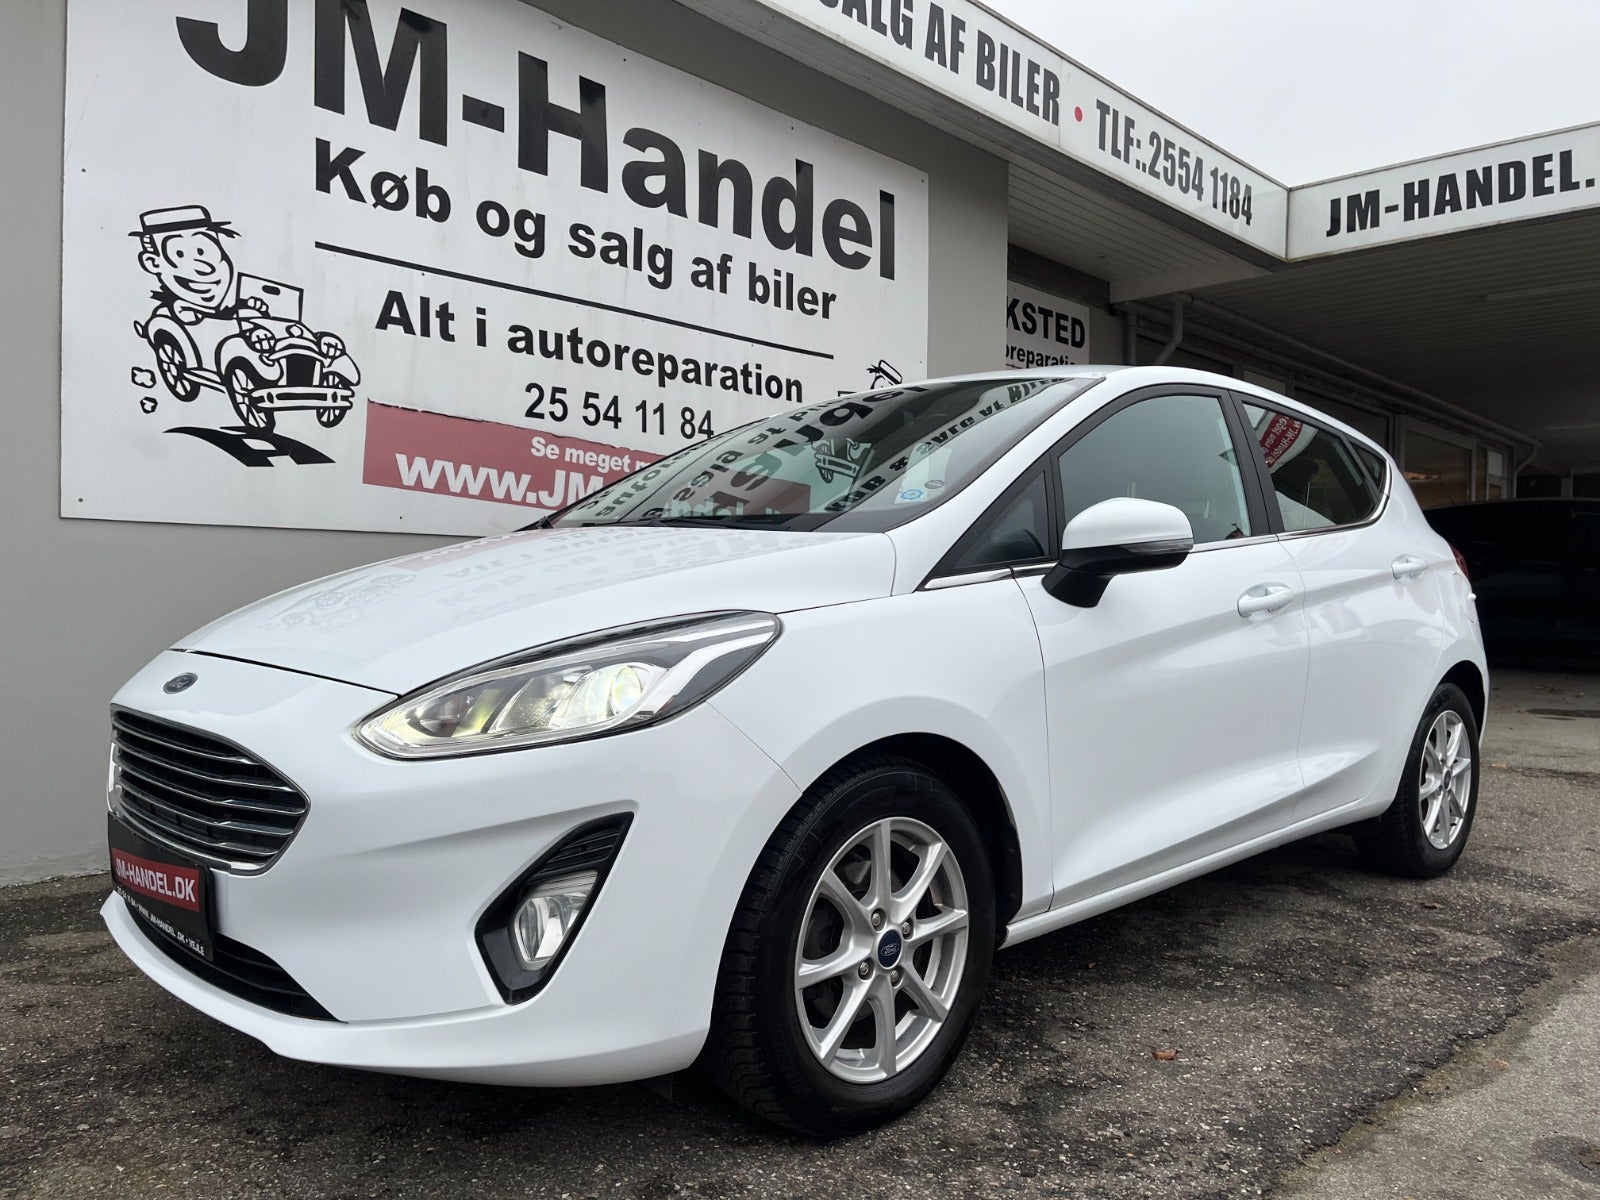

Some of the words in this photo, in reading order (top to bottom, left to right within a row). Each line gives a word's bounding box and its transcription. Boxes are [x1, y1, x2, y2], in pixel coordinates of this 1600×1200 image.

[176, 0, 895, 281] JM-Handel
[925, 1, 966, 74] AF
[976, 29, 1060, 126] BILER
[1210, 166, 1252, 226] 1184
[315, 137, 451, 223] Køb
[476, 200, 545, 259] og
[568, 222, 673, 290] salg
[690, 253, 733, 295] af
[748, 262, 836, 319] biler
[375, 290, 455, 342] Alt
[475, 306, 487, 347] i
[507, 323, 803, 403] autoreparation
[525, 382, 569, 422] 25
[582, 391, 622, 430] 54
[635, 399, 665, 435] 11
[680, 406, 714, 439] 84
[530, 436, 560, 459] Se
[564, 447, 630, 473] meget
[115, 858, 196, 902] JM-HANDEL.DK
